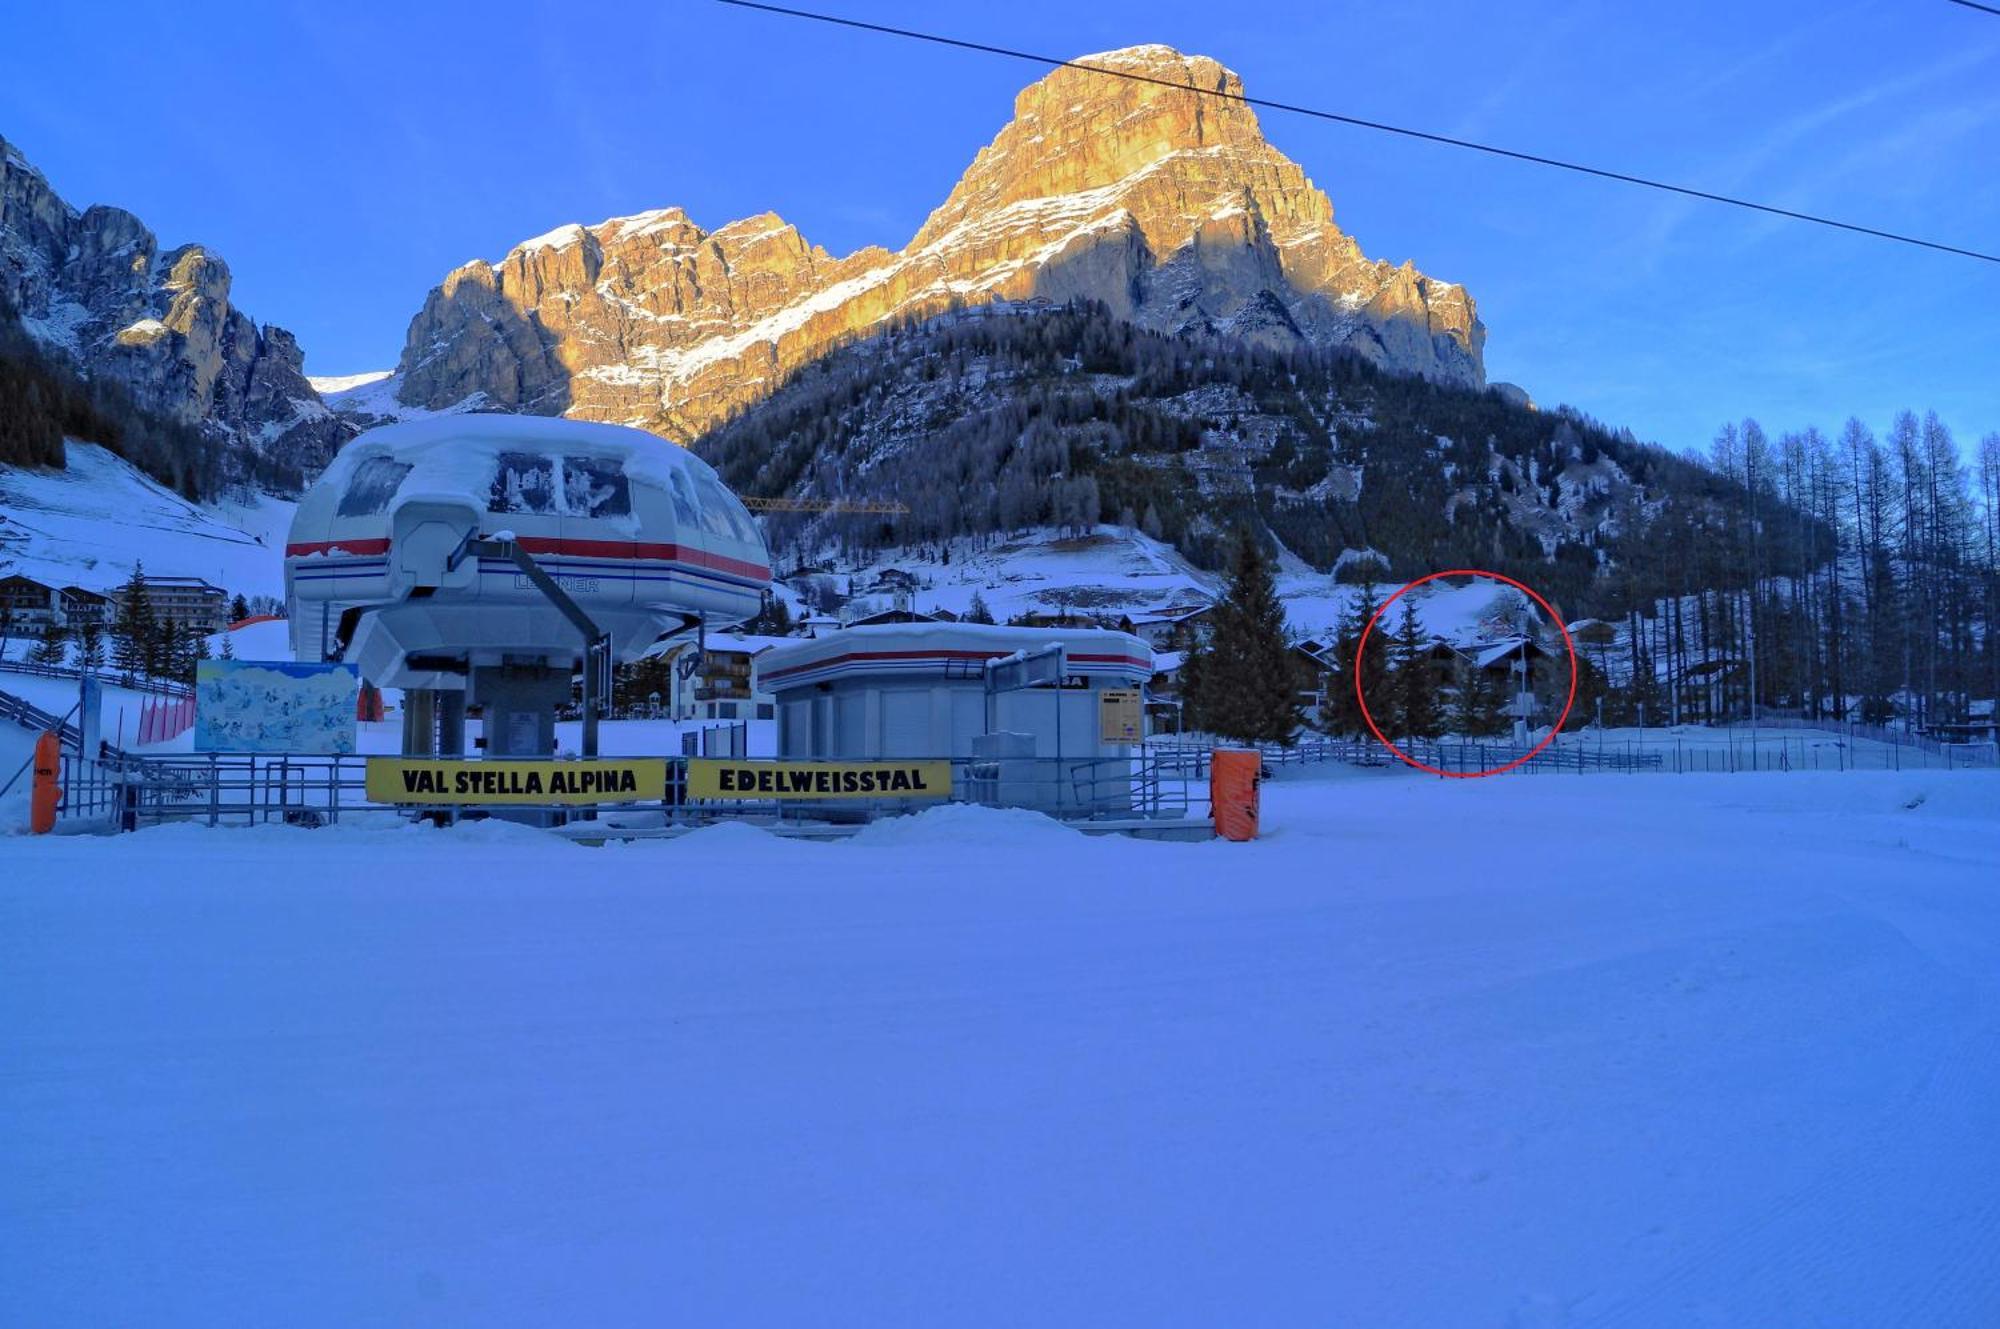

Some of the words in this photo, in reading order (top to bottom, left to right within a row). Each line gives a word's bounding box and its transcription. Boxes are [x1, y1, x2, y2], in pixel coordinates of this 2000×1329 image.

[514, 574, 599, 592] LENER
[402, 770, 449, 793] VAL
[455, 771, 543, 794] STELLA
[549, 770, 637, 794] ALPINA
[719, 769, 927, 793] EDELWEISSTAL
